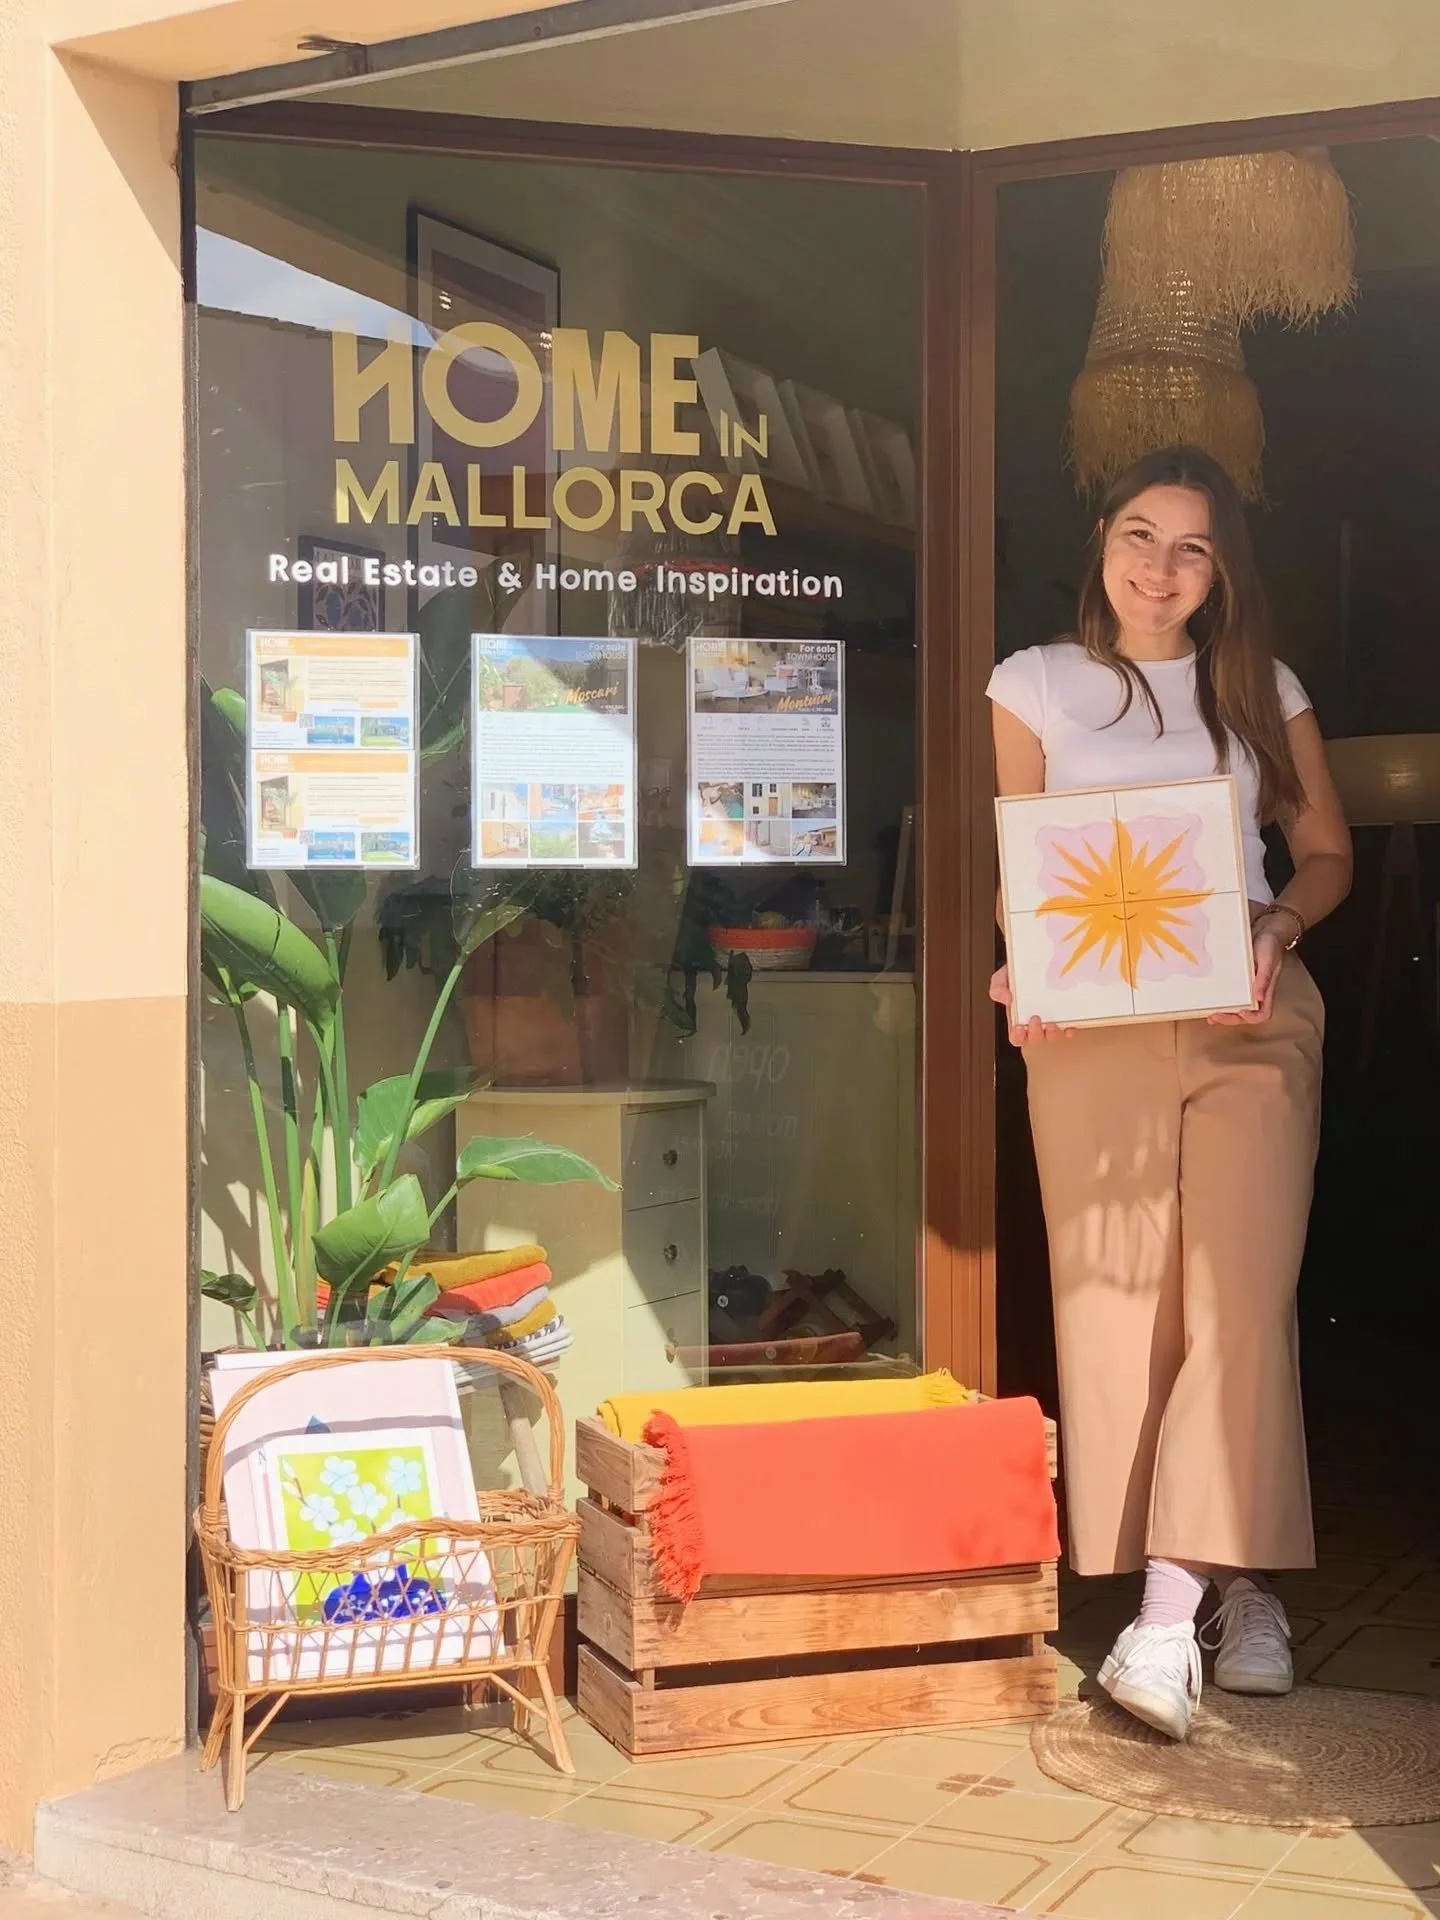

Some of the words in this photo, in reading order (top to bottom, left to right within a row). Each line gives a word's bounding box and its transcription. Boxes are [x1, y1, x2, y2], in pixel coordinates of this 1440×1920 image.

[332, 318, 700, 456] HOME
[719, 408, 768, 458] IN
[335, 458, 778, 536] MALLORCA
[269, 553, 349, 585] Real
[364, 557, 478, 588] Estate
[498, 561, 523, 595] &
[535, 563, 637, 592] Home
[657, 565, 843, 602] Inspiration
[588, 642, 605, 651] For
[787, 652, 836, 662] TOWNHOUSE
[799, 644, 815, 653] For
[816, 644, 836, 653] sale
[564, 681, 620, 705] Moscari
